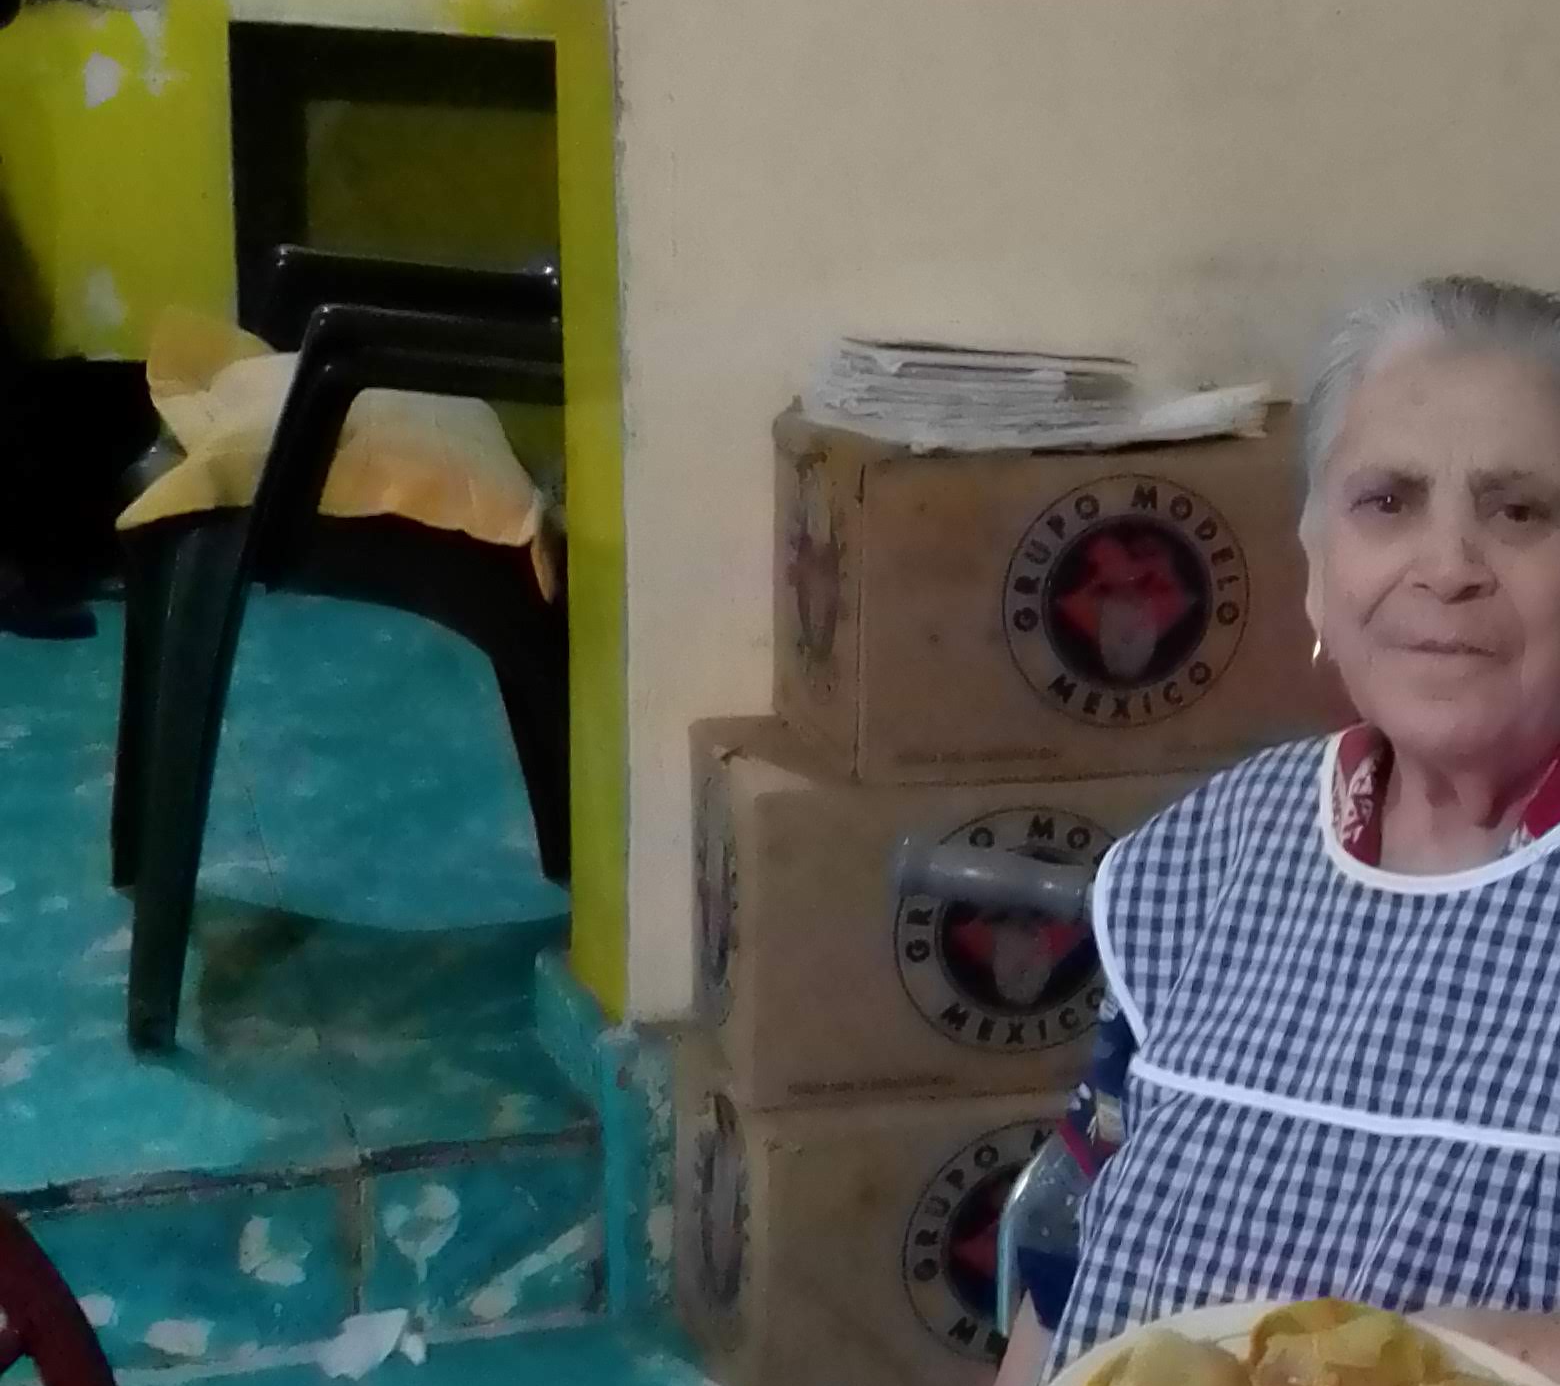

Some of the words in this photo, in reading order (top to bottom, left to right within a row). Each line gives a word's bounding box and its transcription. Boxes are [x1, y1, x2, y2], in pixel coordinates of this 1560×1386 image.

[1013, 493, 1100, 632] GRUPO
[1130, 484, 1240, 626] MODELO
[1048, 661, 1212, 720] MEXICO
[905, 826, 995, 963] GRO
[913, 1144, 1000, 1282] GRUPO
